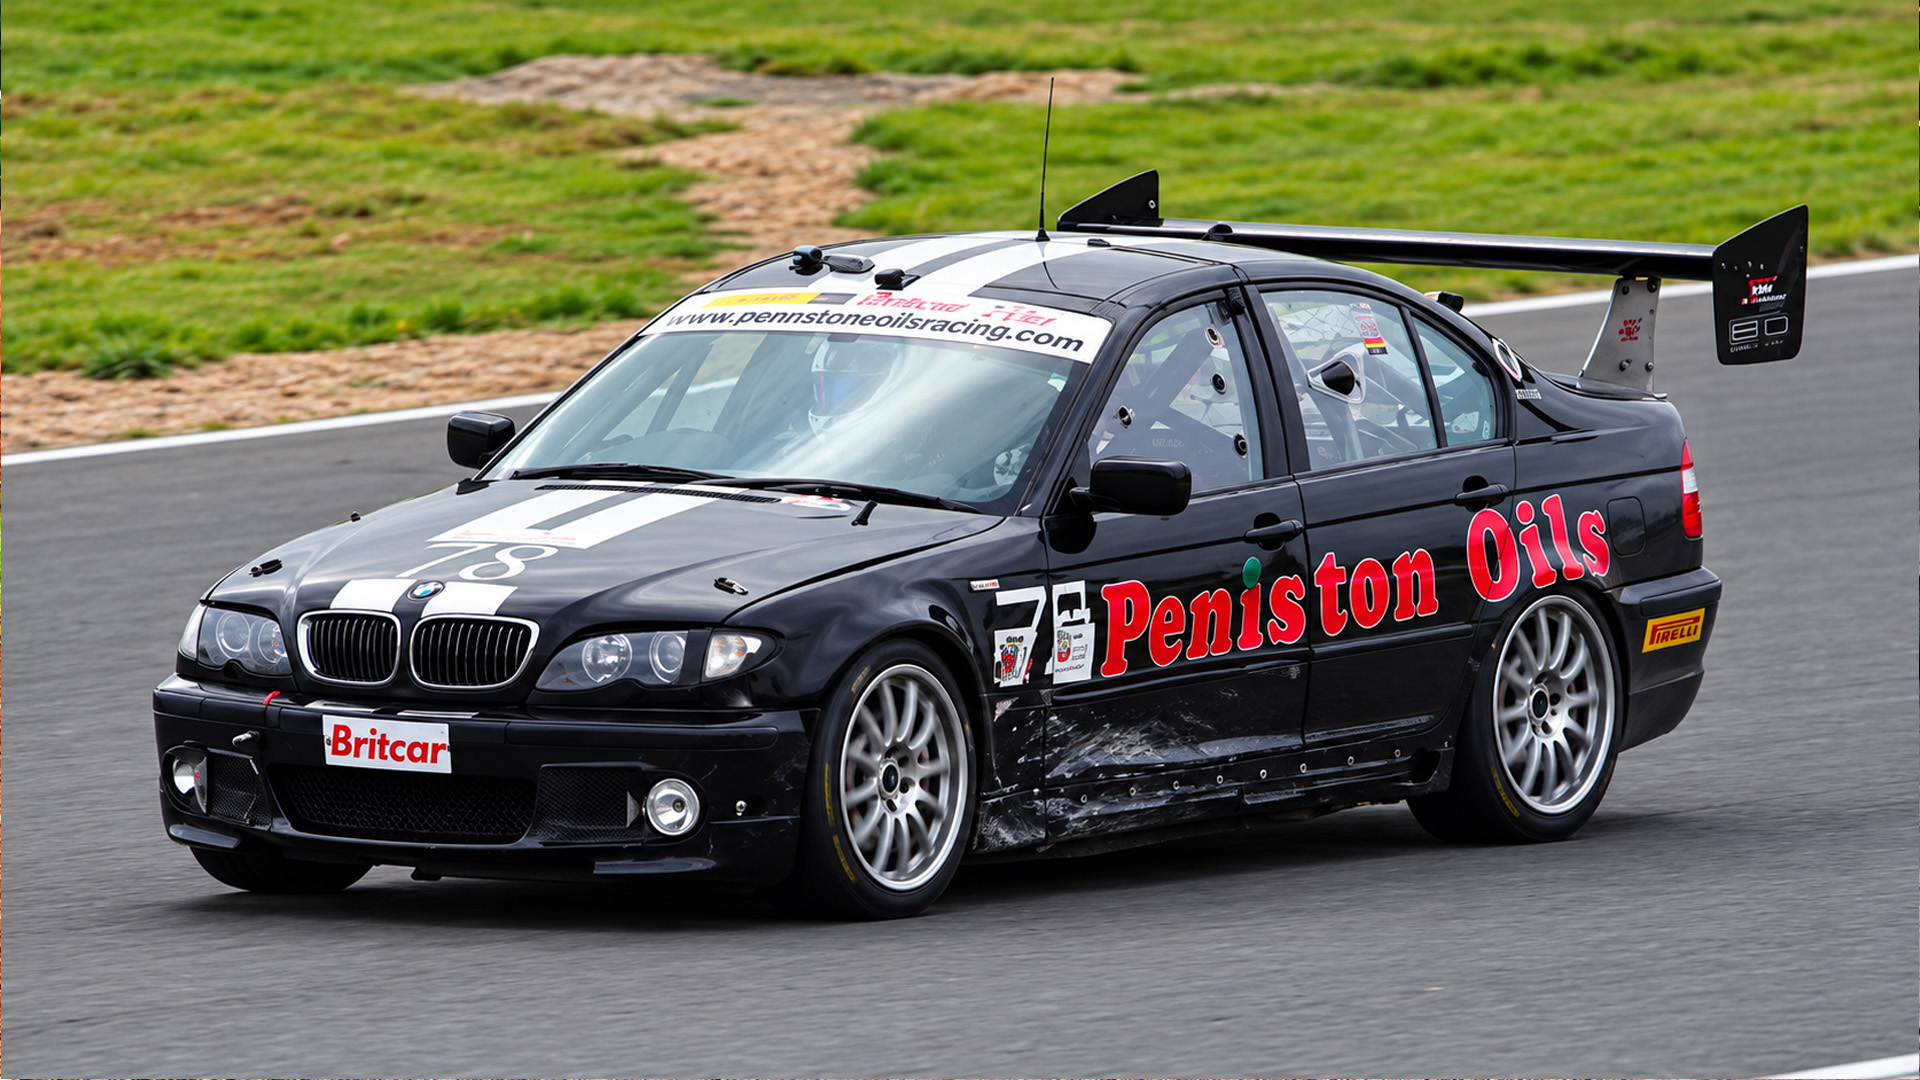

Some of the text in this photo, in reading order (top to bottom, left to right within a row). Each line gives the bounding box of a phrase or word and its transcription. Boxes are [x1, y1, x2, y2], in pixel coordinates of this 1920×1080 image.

[666, 308, 1084, 352] www.pennstoneoilsracing.com
[394, 541, 559, 581] 78
[1100, 494, 1610, 678] Peniston Oils
[1648, 615, 1701, 646] PIRELLI
[331, 723, 447, 764] Britcar
